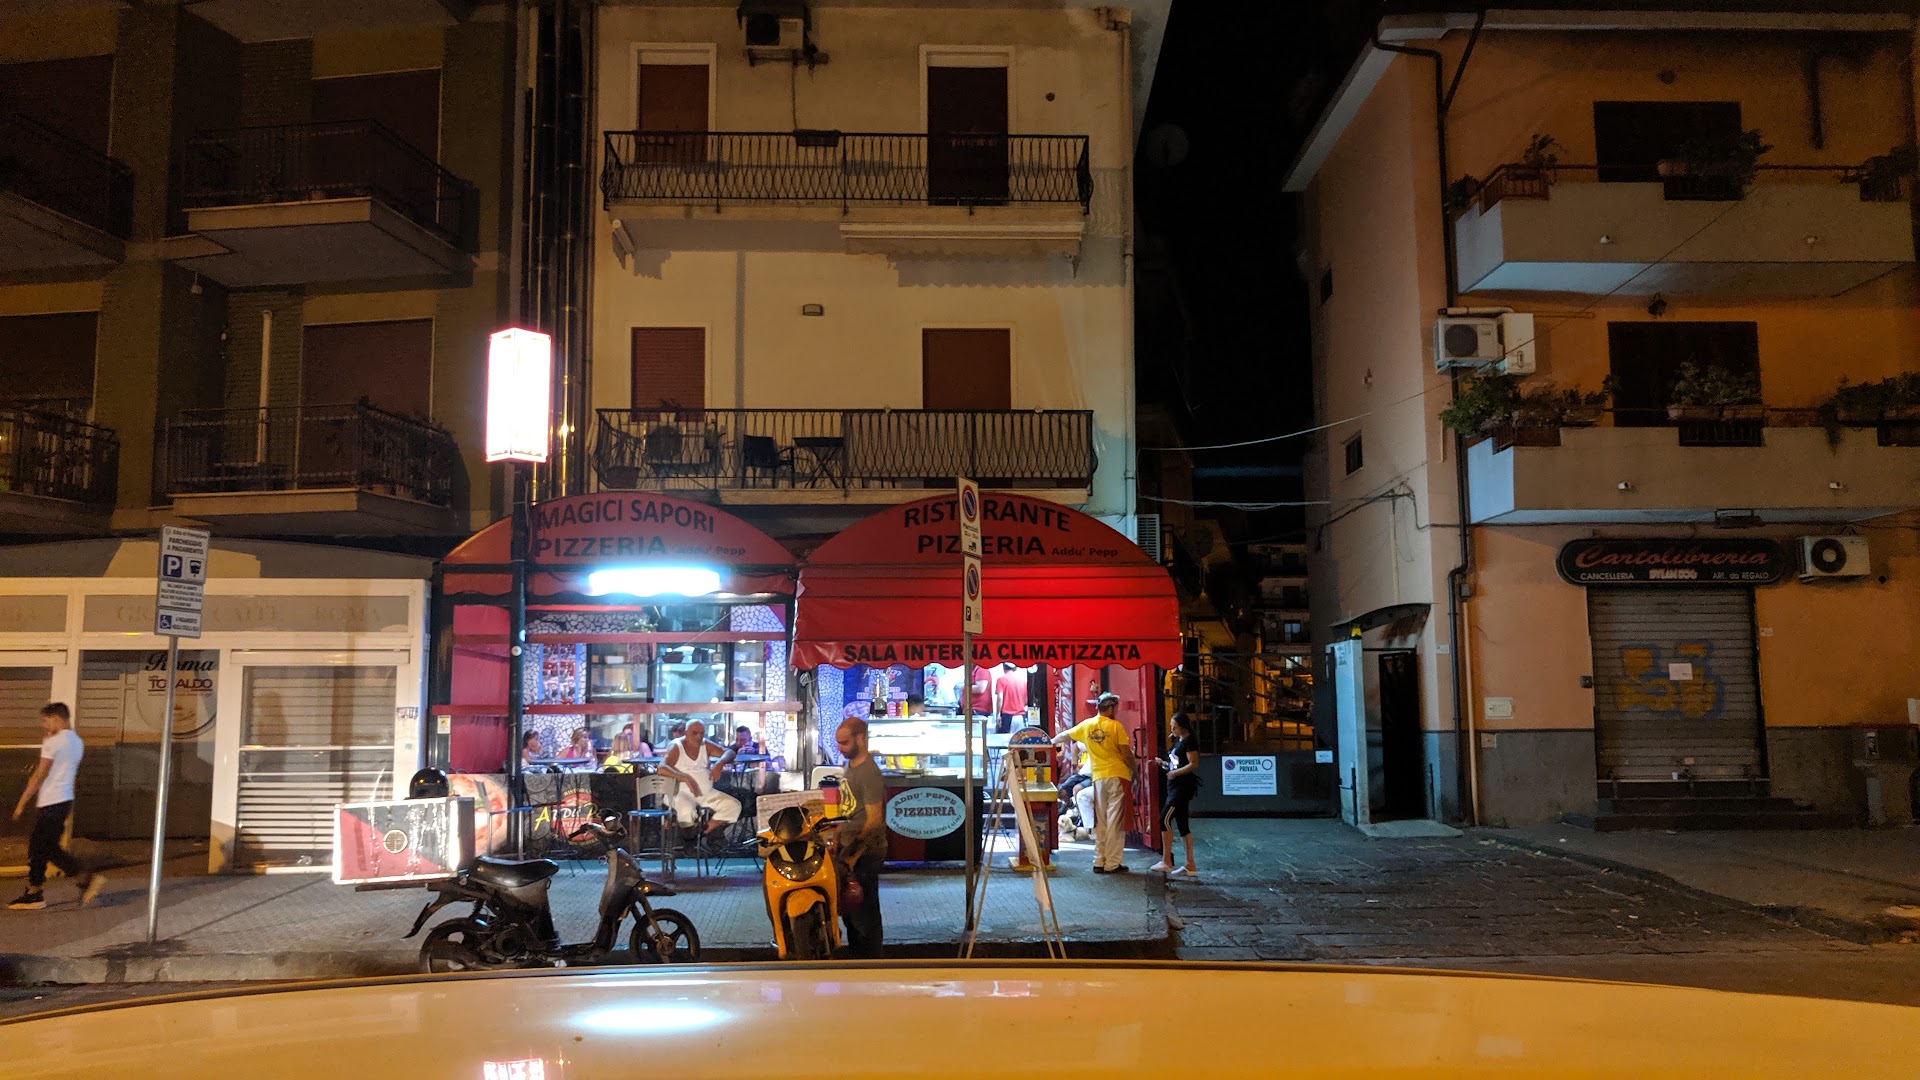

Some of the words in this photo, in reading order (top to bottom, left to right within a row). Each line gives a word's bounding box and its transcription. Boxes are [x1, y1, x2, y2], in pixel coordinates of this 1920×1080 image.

[538, 500, 623, 530] MAGICI
[630, 500, 715, 533] SAPORI
[904, 500, 1071, 532] RISTRANTE
[535, 535, 667, 557] PIZZERIA
[917, 535, 1046, 555] PIZERIA
[1089, 547, 1119, 558] Pepp
[166, 556, 180, 576] P
[1574, 545, 1769, 568] Cartolibreria
[1580, 572, 1635, 580] CANCELLERIA
[1741, 571, 1769, 580] REGALO
[145, 651, 216, 671] Rma
[844, 644, 897, 662] SALA
[996, 643, 1142, 660] CLIMATIZZATA
[148, 679, 213, 688] TOALDO
[1236, 757, 1261, 766] PROPRIETÀ
[894, 793, 922, 806] ADDU'
[925, 792, 957, 805] PEPPE
[894, 806, 957, 818] PIZZERIA
